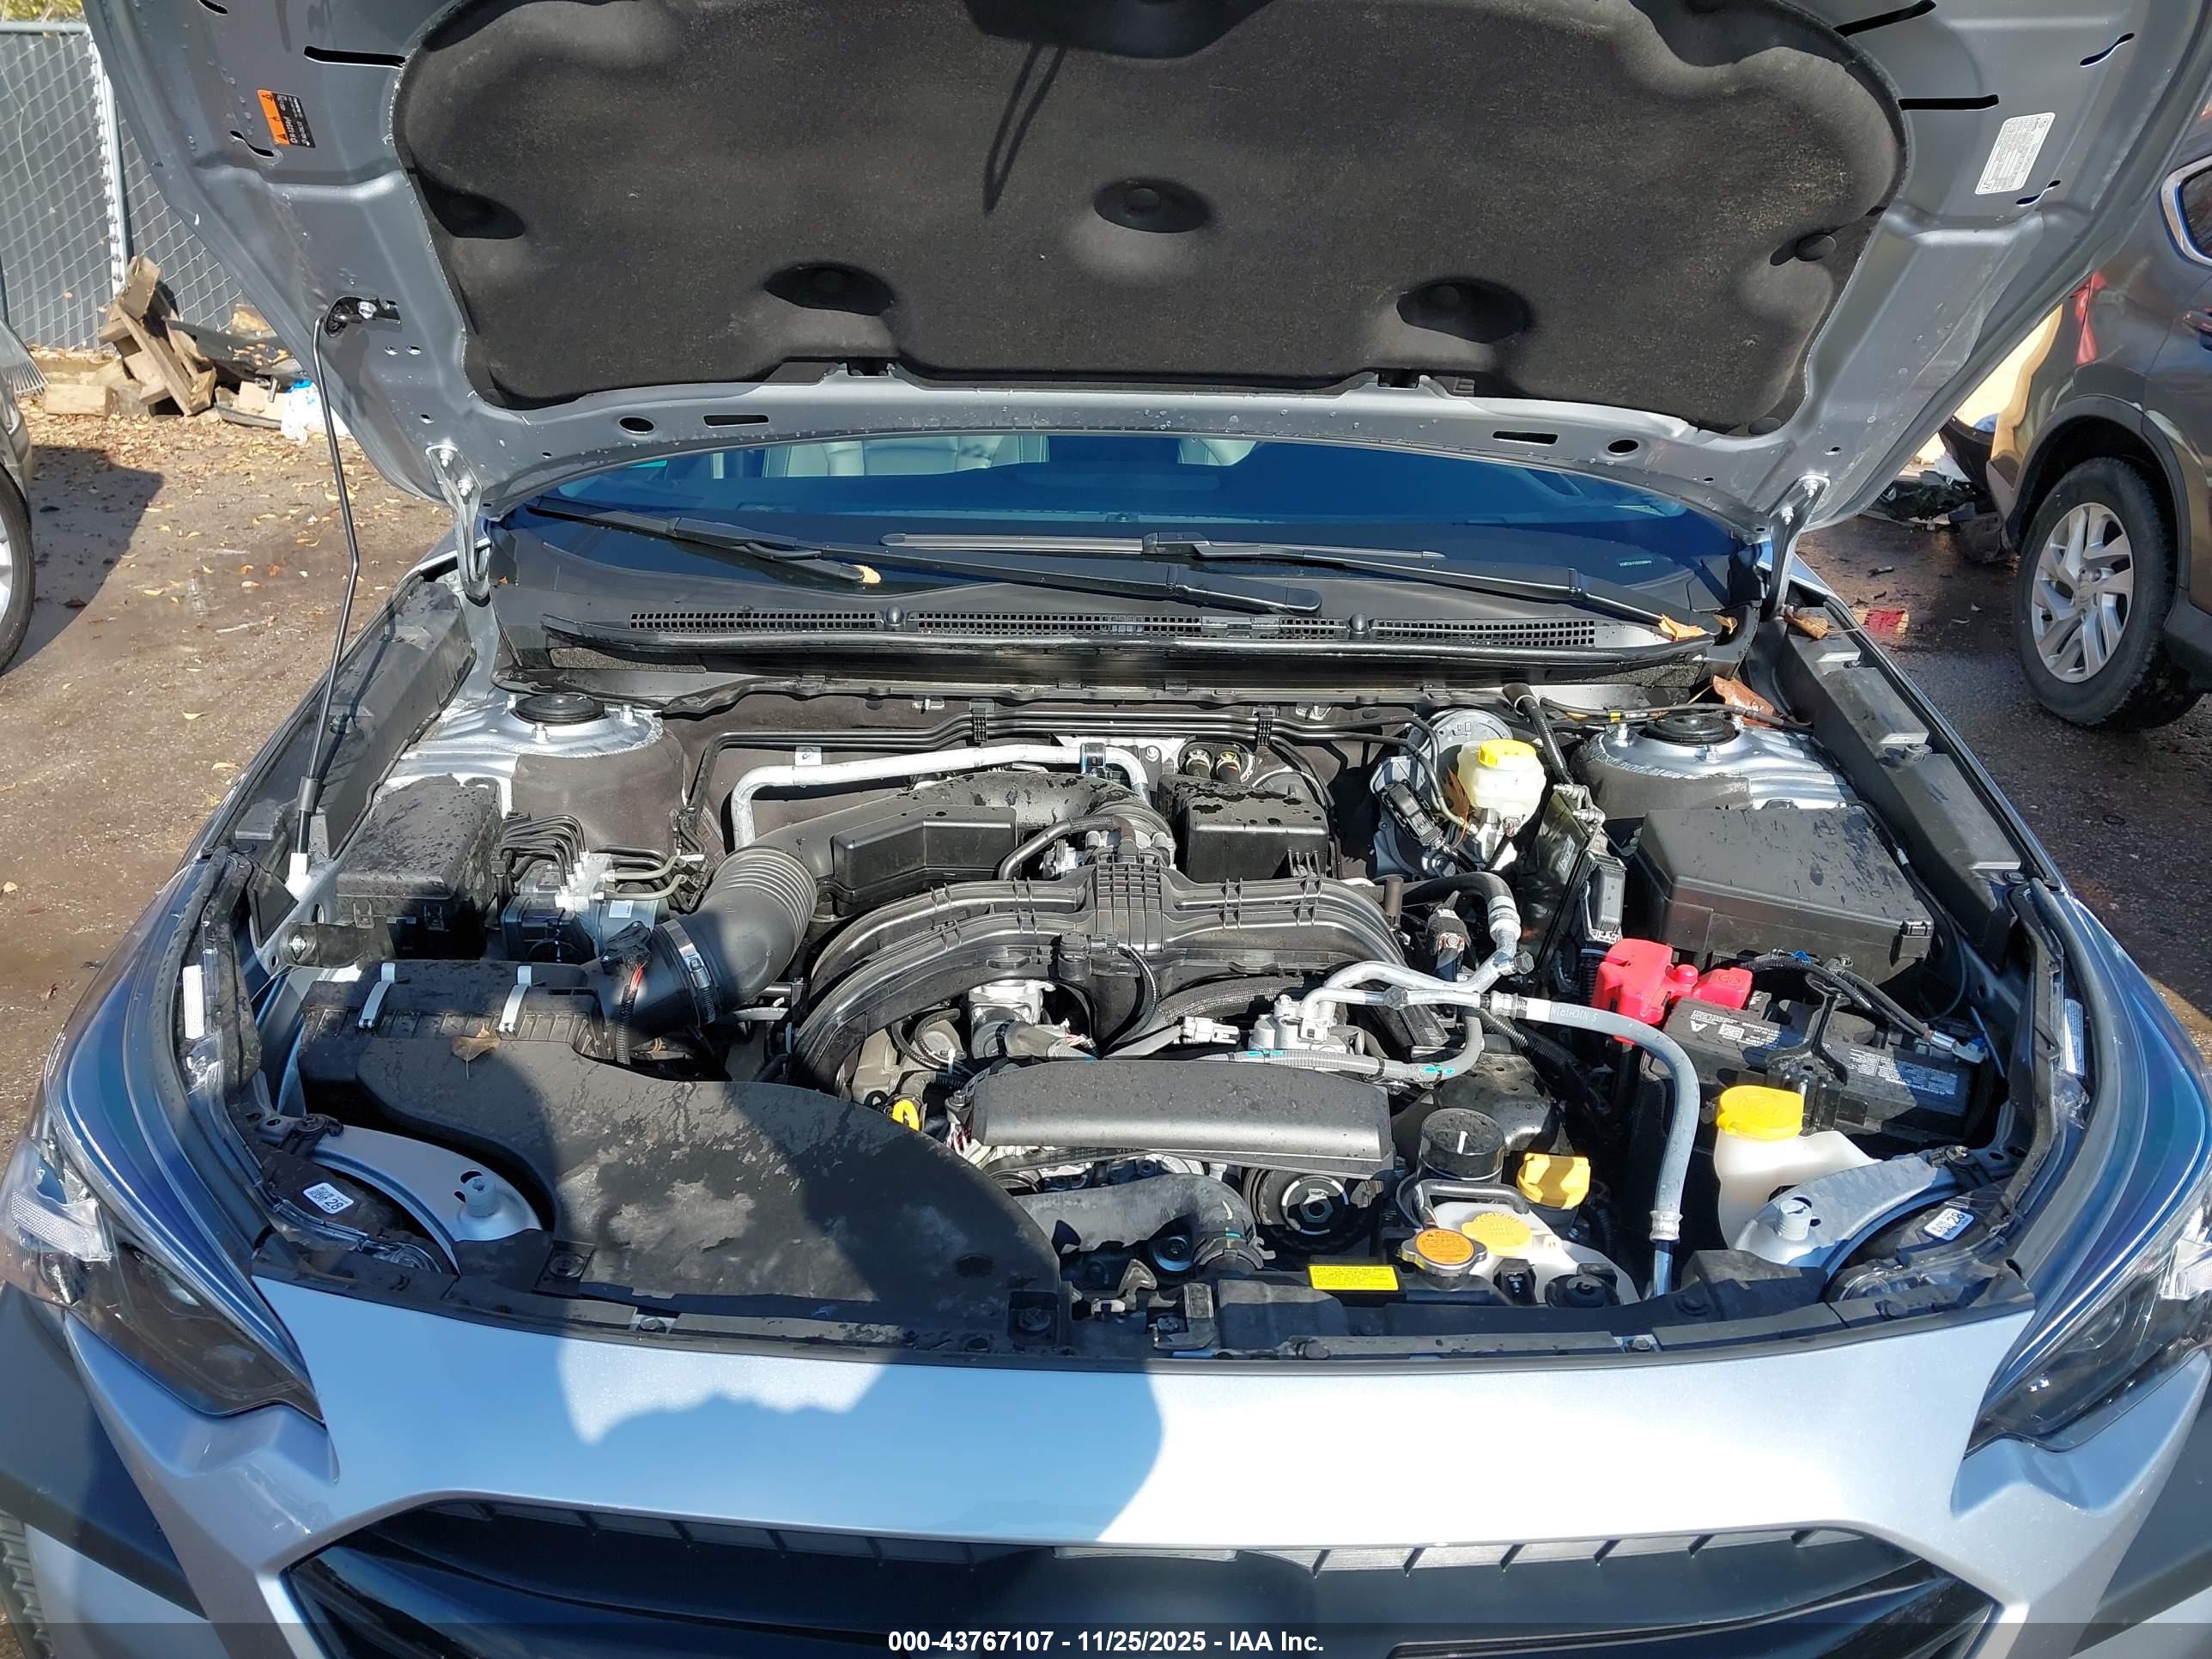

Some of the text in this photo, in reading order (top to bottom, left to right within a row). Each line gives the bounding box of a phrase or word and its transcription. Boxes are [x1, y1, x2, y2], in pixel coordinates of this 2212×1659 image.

[1551, 1005, 1589, 1021] NICHIRIN
[324, 1198, 344, 1210] 28
[1946, 1212, 1966, 1224] 28
